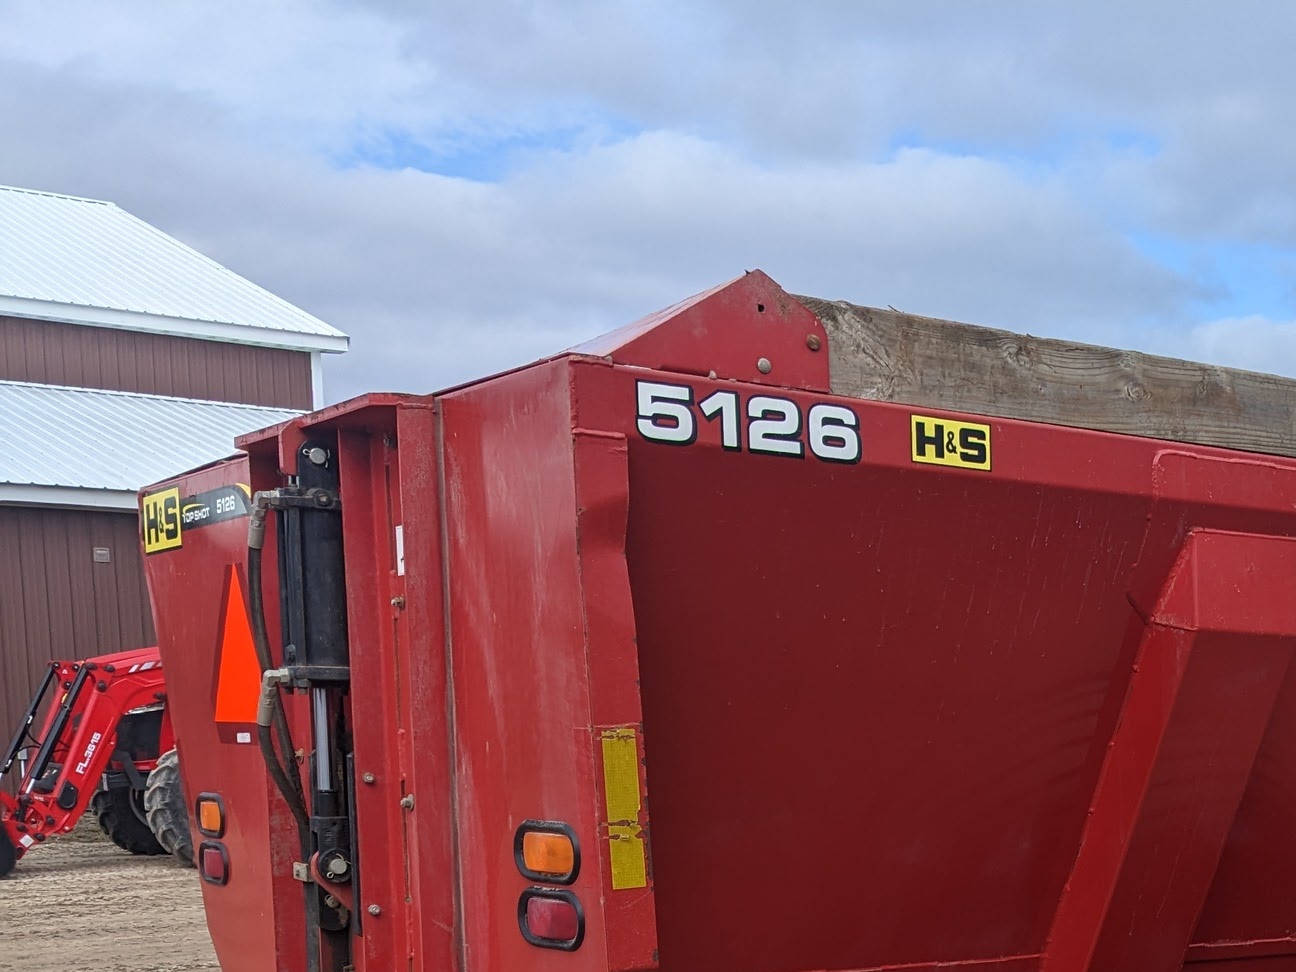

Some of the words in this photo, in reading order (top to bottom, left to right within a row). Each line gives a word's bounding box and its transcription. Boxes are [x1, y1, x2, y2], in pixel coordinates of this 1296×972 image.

[636, 380, 862, 463] 5126
[915, 422, 987, 464] H&S
[145, 496, 178, 545] H&S
[194, 507, 210, 520] SHOT
[216, 495, 235, 514] 5126
